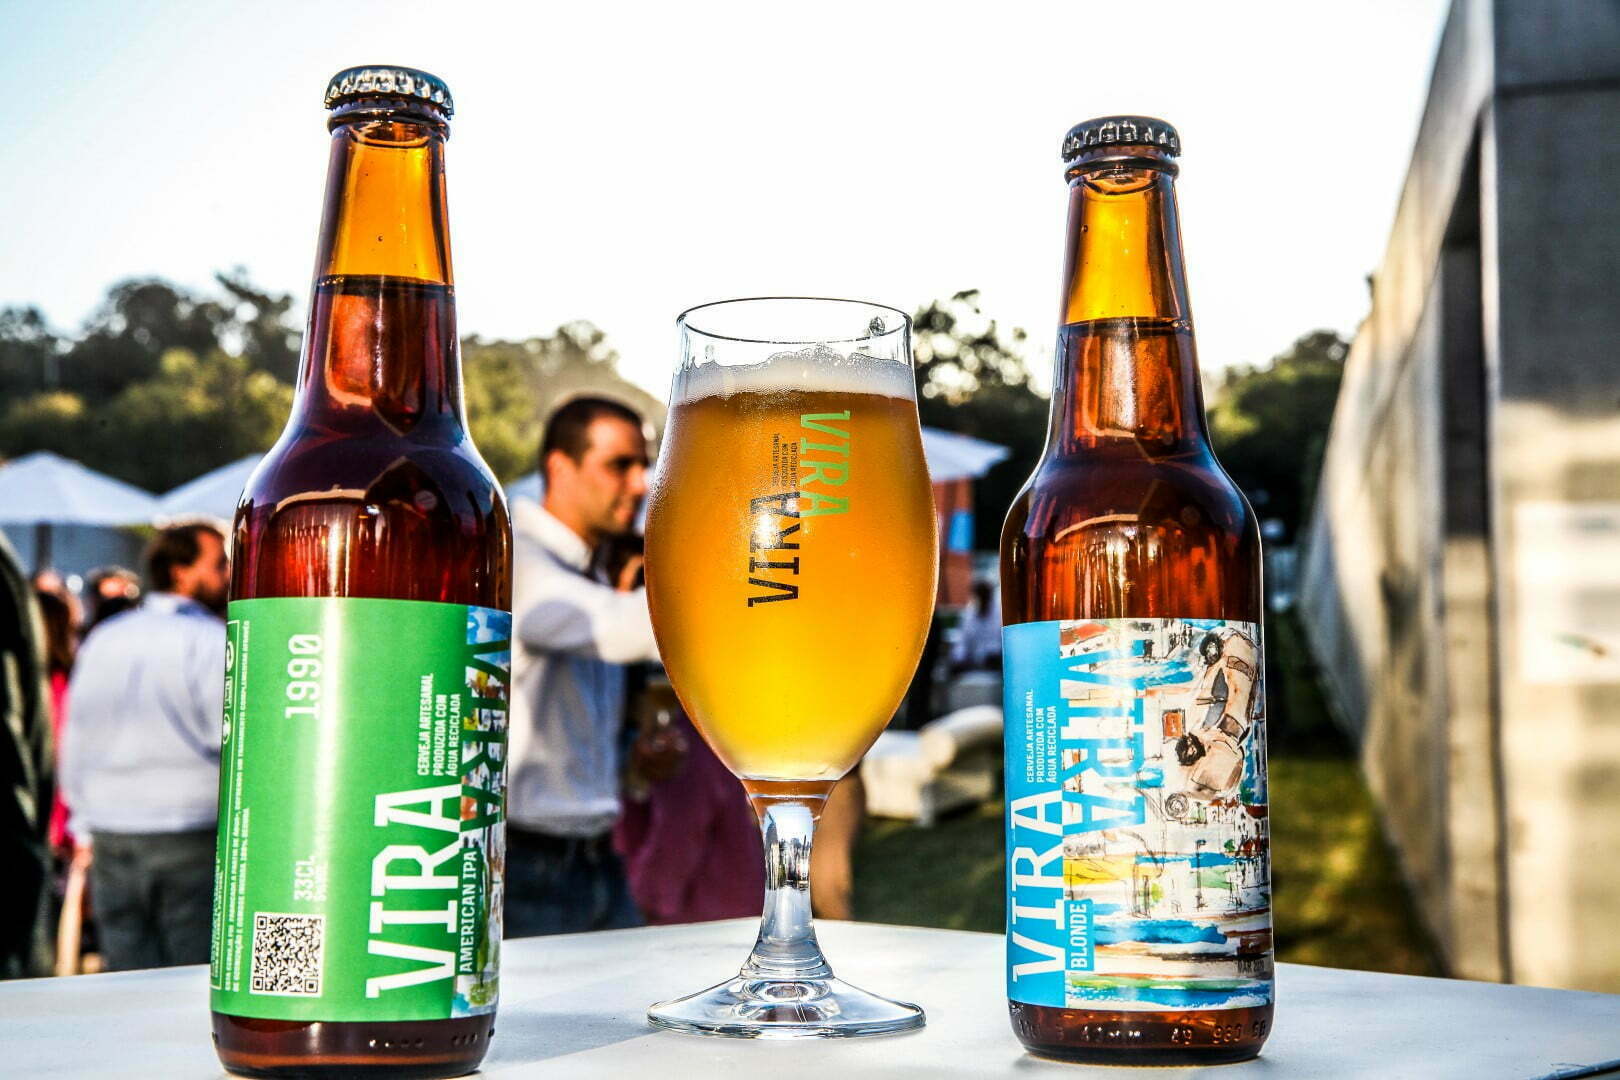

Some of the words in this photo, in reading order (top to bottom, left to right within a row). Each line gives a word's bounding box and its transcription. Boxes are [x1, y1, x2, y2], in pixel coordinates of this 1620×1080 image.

[799, 410, 851, 518] VIRA
[747, 491, 801, 608] VIRA
[285, 634, 322, 719] 1990
[419, 673, 433, 729] ARTESANAL
[435, 694, 447, 718] COM
[449, 693, 461, 747] RECICLADA
[1025, 689, 1034, 741] ARTESANAL
[1036, 708, 1044, 729] COM
[1046, 706, 1057, 756] RECICLADA
[417, 731, 431, 776] CERVEJA
[433, 719, 446, 777] PRODUZIDA
[446, 750, 458, 777] ÁGUA
[1026, 743, 1034, 783] CERVEJA
[1036, 730, 1045, 783] PRODUZIDA
[1059, 640, 1145, 834] VIRA
[1046, 758, 1057, 783] ÁGUA
[293, 856, 316, 902] 33CL
[365, 783, 462, 998] VIRA
[462, 850, 478, 880] IPA
[1010, 789, 1065, 982] VIRA
[460, 883, 477, 973] AMERICAN
[1070, 902, 1088, 968] BLONDE
